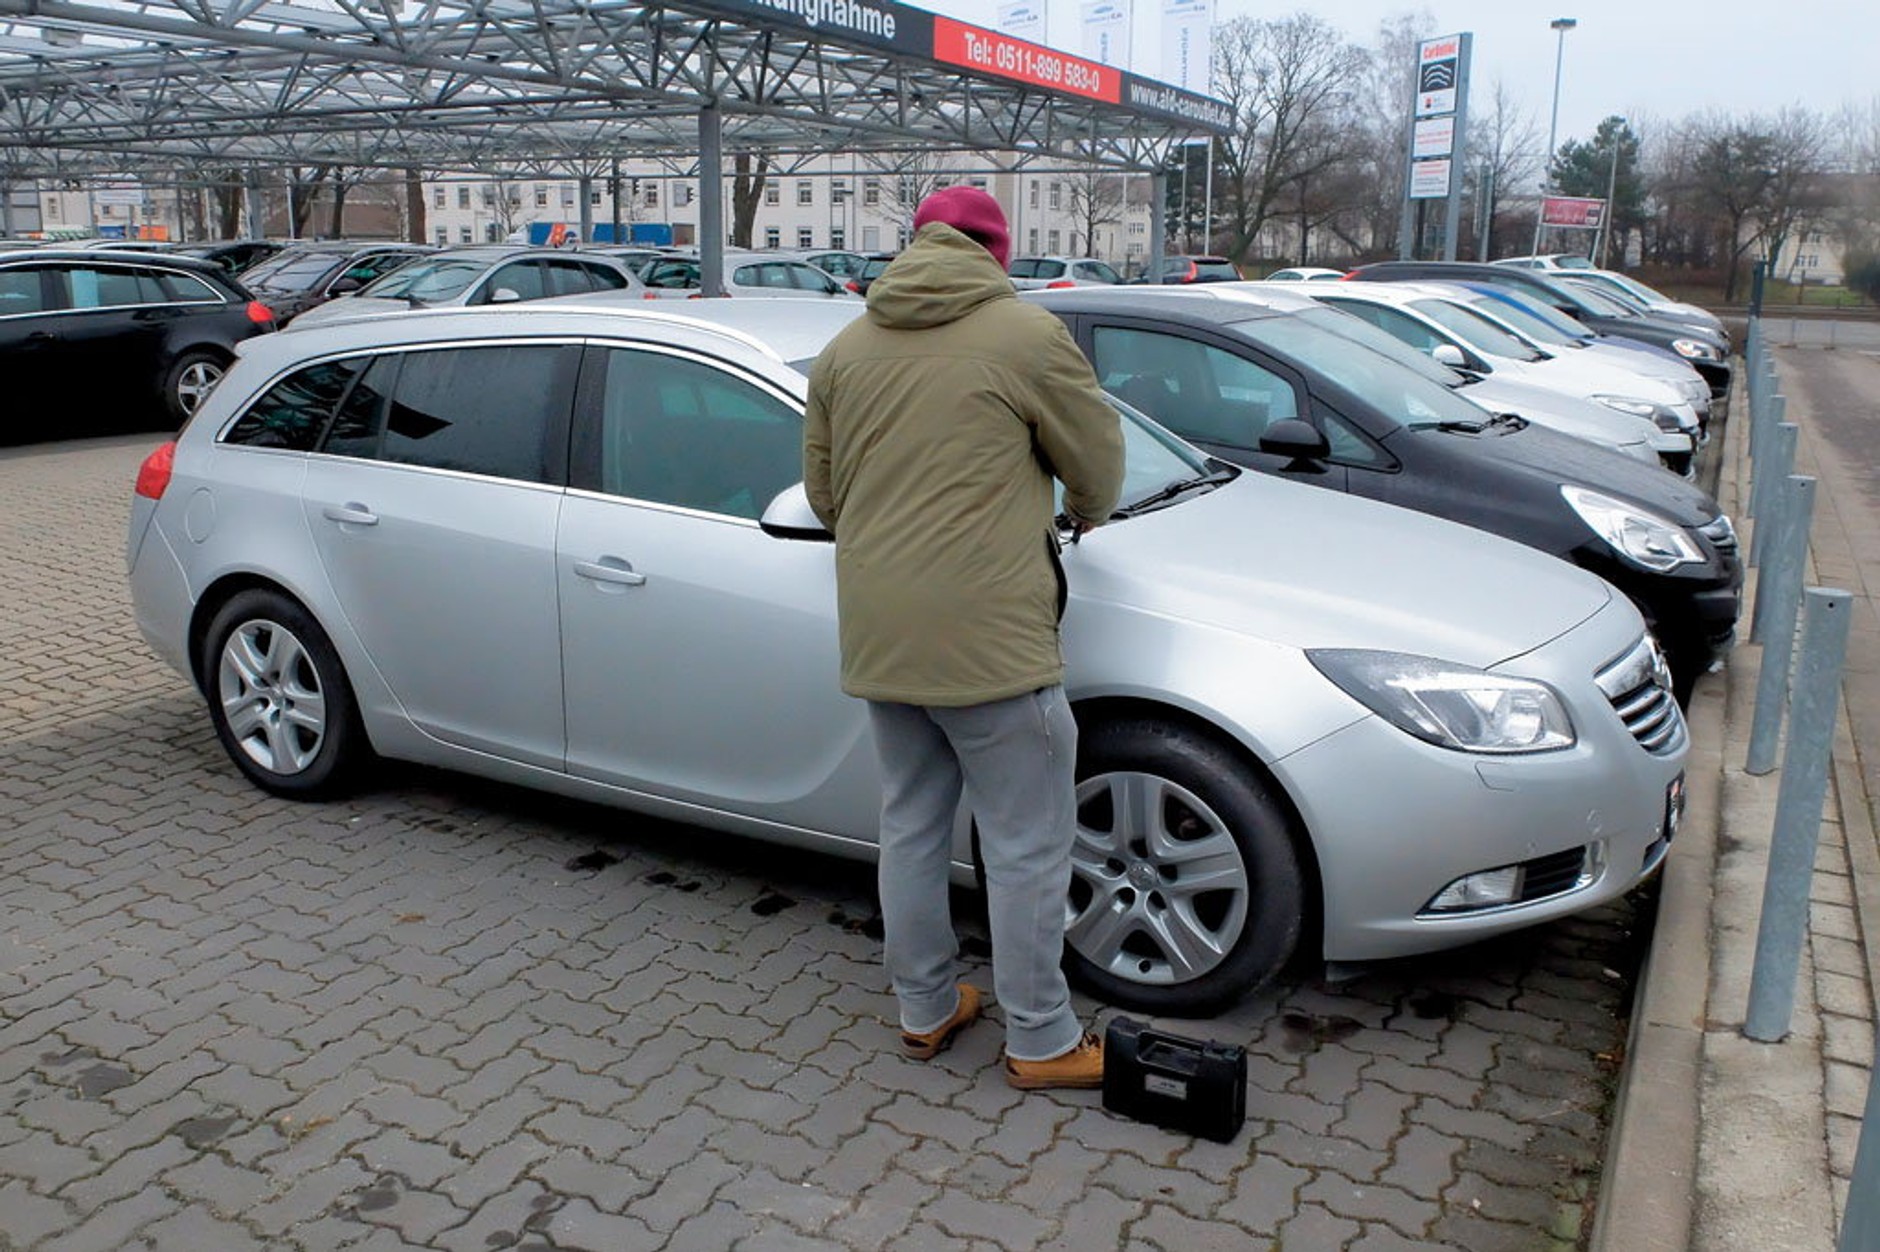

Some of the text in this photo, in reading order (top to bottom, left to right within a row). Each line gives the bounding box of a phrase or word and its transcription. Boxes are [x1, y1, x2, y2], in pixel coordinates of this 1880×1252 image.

[752, 0, 897, 39] ngnahme
[964, 31, 993, 64] Tel:
[996, 42, 1062, 82] 0511-899
[1064, 62, 1100, 93] 583-0
